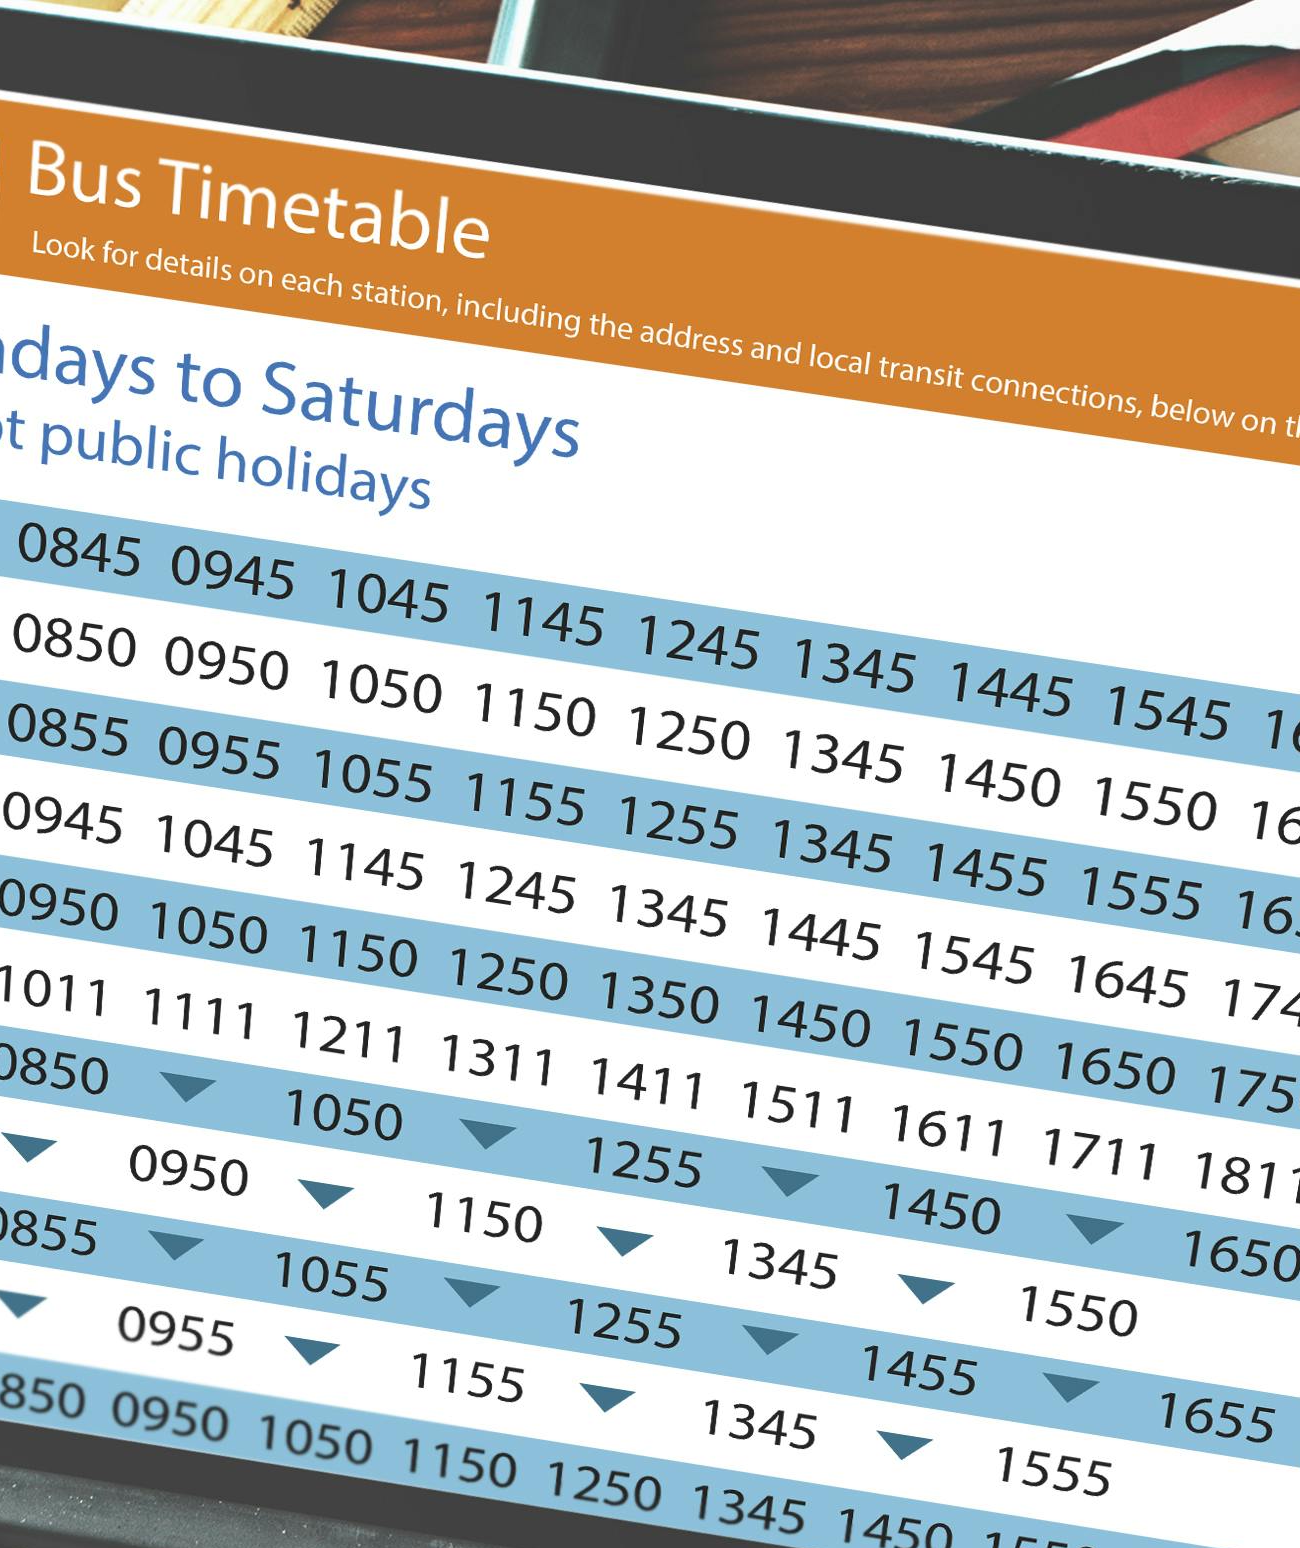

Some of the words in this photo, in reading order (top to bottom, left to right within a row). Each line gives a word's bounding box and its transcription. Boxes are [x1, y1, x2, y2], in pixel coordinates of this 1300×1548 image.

[30, 140, 140, 208] Bus
[159, 158, 489, 259] Timetable
[33, 231, 95, 261] Look
[103, 240, 138, 267] for
[146, 248, 232, 281] details
[239, 267, 272, 287] on
[282, 273, 342, 297] each
[351, 282, 447, 316] station,
[457, 293, 580, 338] including
[590, 313, 632, 339] the
[640, 323, 742, 356] address
[751, 342, 801, 364] and
[810, 344, 870, 375] local
[879, 357, 964, 388] transit
[971, 375, 1142, 418] connections,
[1151, 394, 1235, 427] below
[1242, 414, 1276, 434] on
[42, 420, 200, 475] public
[218, 436, 429, 516] holidays
[177, 354, 240, 407] to
[263, 362, 578, 466] Saturdays
[18, 522, 141, 577] 0845
[171, 545, 295, 600] 0945
[331, 568, 449, 623] 1045
[485, 591, 604, 647] 1145
[640, 615, 760, 670] 1245
[797, 638, 917, 693] 1345
[953, 662, 1073, 717] 1445
[1110, 685, 1231, 741] 1545
[3, 791, 122, 845] 0945
[158, 814, 273, 868] 1045
[308, 838, 424, 891] 1145
[460, 861, 576, 914] 1245
[611, 884, 728, 938] 1345
[764, 908, 882, 961] 1445
[917, 931, 1035, 985] 1545
[1071, 955, 1189, 1008] 1645
[288, 1089, 403, 1141] 1050
[588, 1136, 702, 1189] 1255
[885, 1183, 1001, 1235] 1450
[276, 1251, 389, 1302] 1055
[569, 1298, 682, 1349] 1255
[864, 1345, 978, 1396] 1455
[1161, 1392, 1276, 1443] 1655
[112, 1391, 228, 1441] 0950
[262, 1415, 372, 1465] 1050
[405, 1438, 517, 1488] 1150
[549, 1462, 662, 1511] 1250
[695, 1485, 806, 1534] 1345
